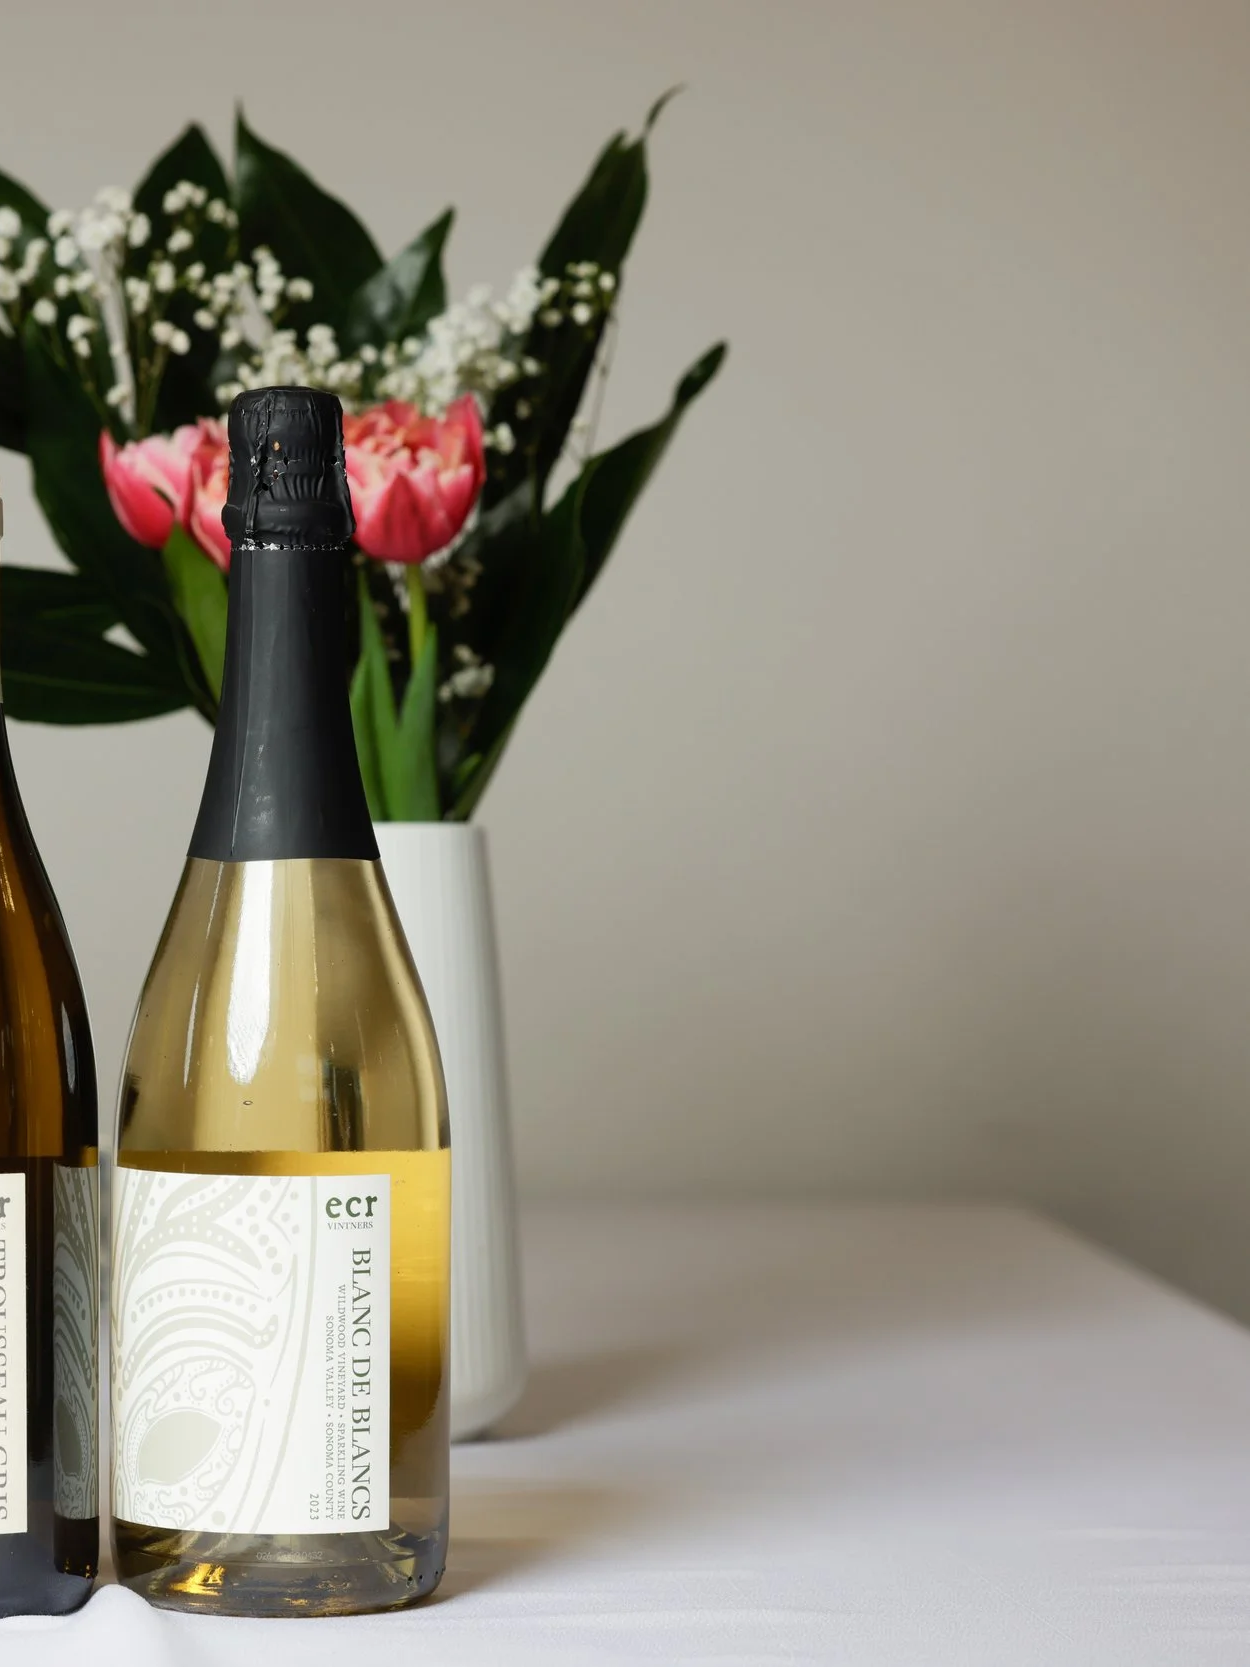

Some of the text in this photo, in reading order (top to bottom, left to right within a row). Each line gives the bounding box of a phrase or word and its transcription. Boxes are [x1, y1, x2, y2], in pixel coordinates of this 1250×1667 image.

[326, 1196, 378, 1218] ecr
[327, 1220, 374, 1231] VINTNERS
[325, 1315, 335, 1521] SONOMA VALLEY SONOMA COUNTY
[336, 1283, 347, 1521] WILDWOOD VINEYARD SPARKLING WINE
[352, 1248, 371, 1520] BLANC DE BLANCS
[309, 1493, 320, 1521] 2023
